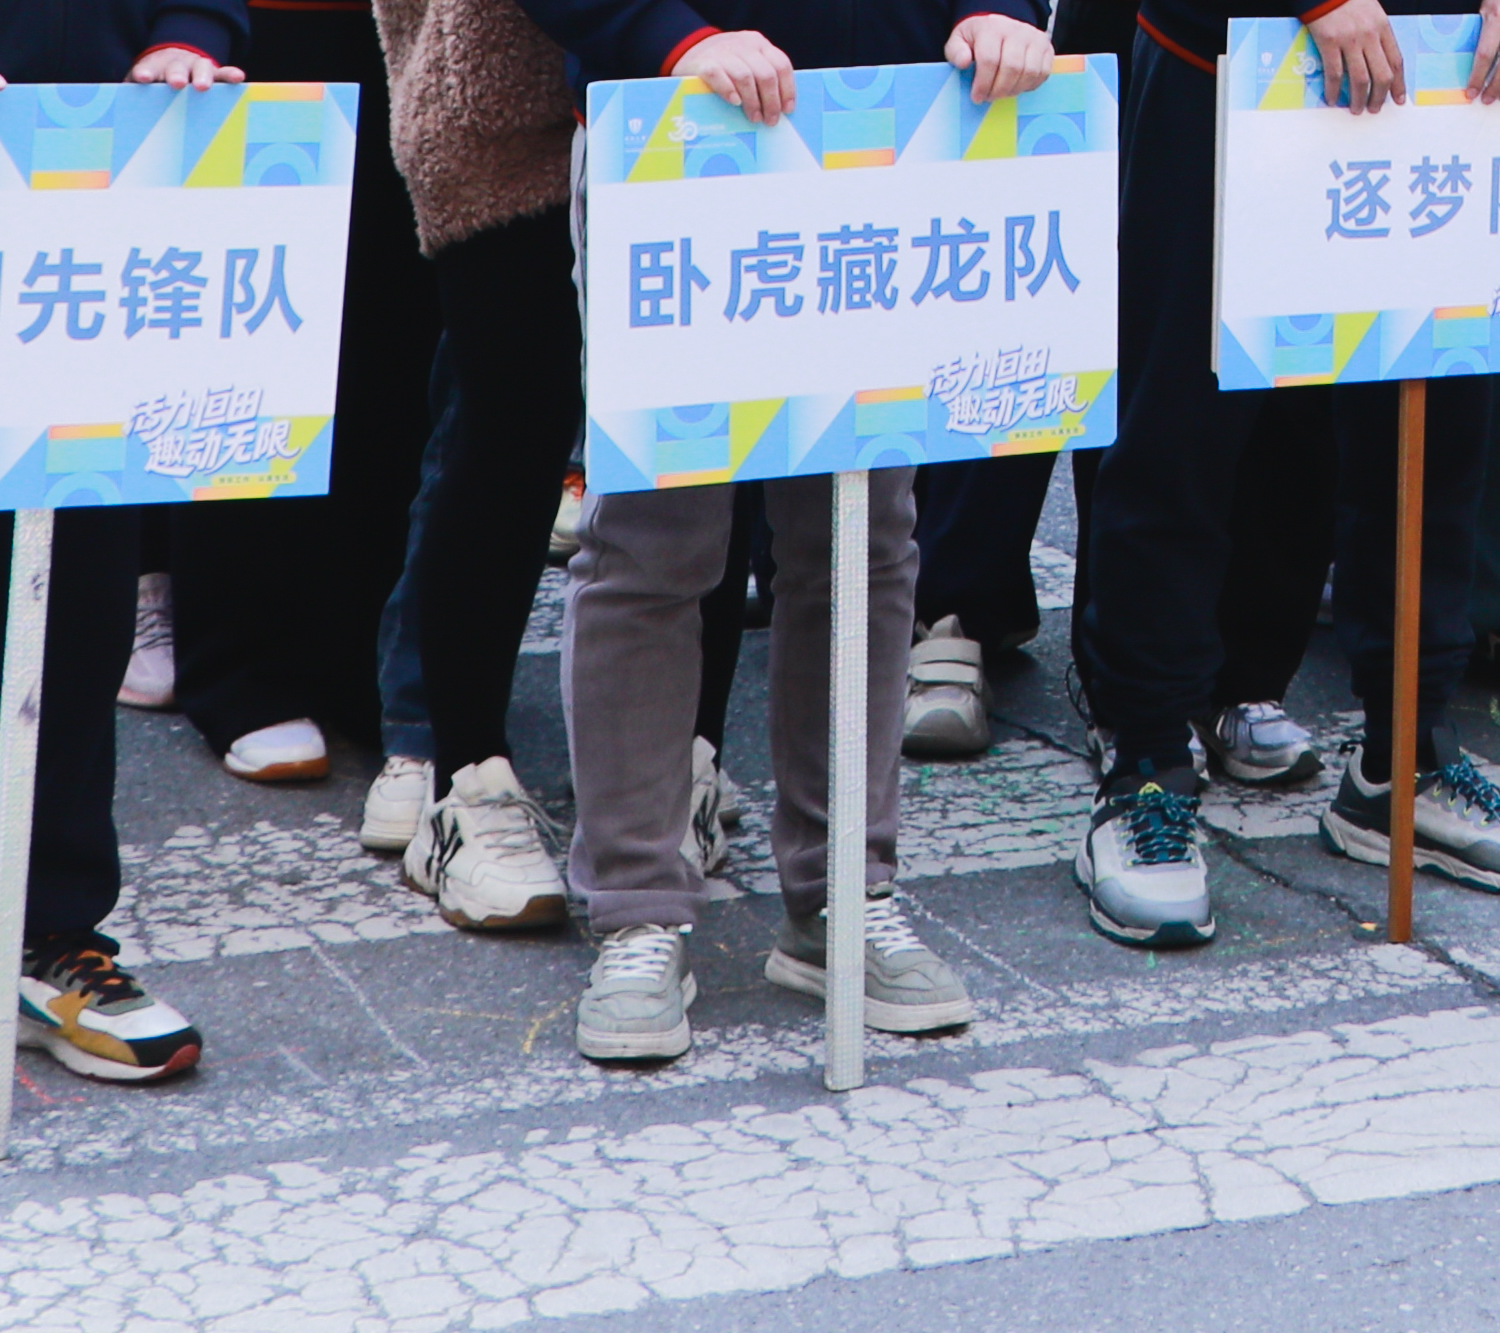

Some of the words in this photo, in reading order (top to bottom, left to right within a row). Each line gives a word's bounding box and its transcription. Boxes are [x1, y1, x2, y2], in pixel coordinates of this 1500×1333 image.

[629, 209, 1082, 329] 卧虎藏龙队
[922, 344, 1050, 406] 活力恒田
[946, 375, 1089, 436] 趣动无限
[122, 384, 263, 445] 活力恒田
[144, 419, 300, 479] 趣动无限
